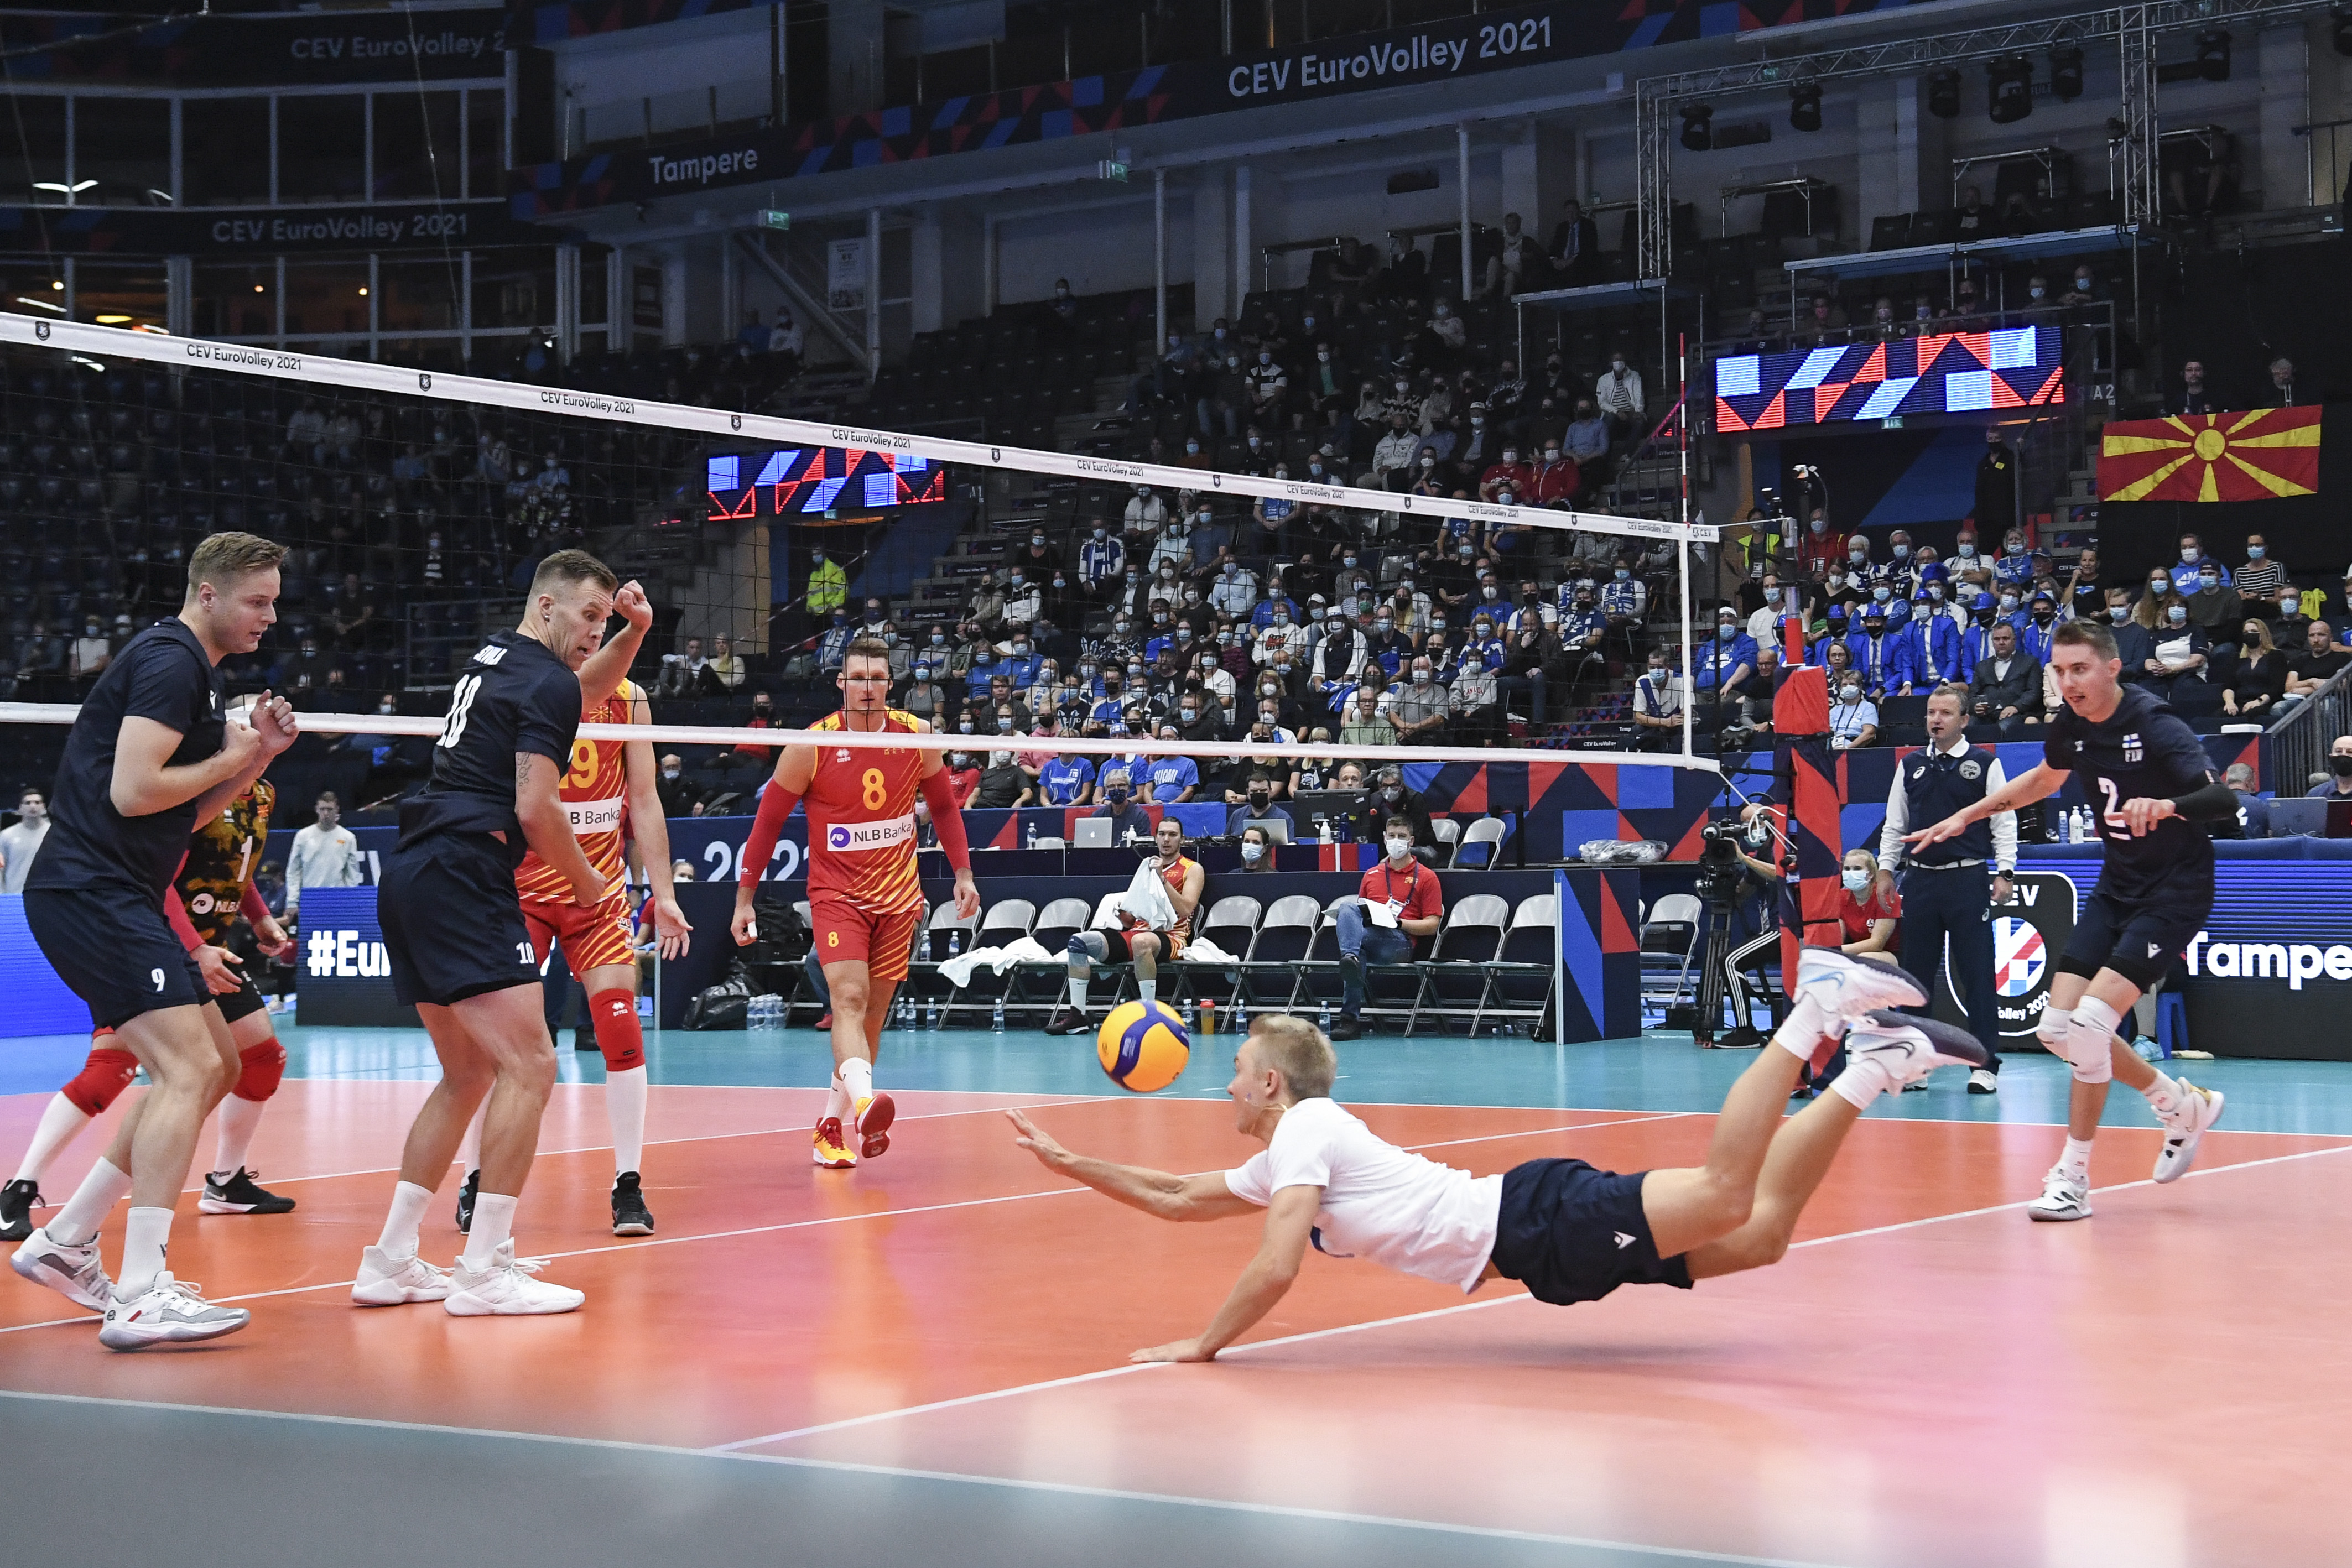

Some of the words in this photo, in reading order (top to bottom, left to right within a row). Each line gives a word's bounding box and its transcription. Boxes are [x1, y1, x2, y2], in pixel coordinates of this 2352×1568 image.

[291, 37, 344, 59] CEV
[352, 32, 485, 58] EuroVolley
[1229, 60, 1291, 97] CEV
[1302, 35, 1468, 87] EuroVolley
[1480, 17, 1551, 58] 2021
[649, 148, 758, 184] Tampere
[212, 220, 264, 243] CEV
[272, 216, 404, 242] EuroVolley
[413, 213, 468, 238] 2021
[187, 343, 211, 359] CEV
[214, 347, 274, 372] EuroVolley
[277, 357, 301, 371] 2021
[540, 391, 560, 405] CEV
[563, 394, 612, 414] EuroVolley
[615, 402, 634, 414] 2021
[832, 429, 849, 441] CEV
[851, 431, 892, 449] EuroVolley
[893, 436, 910, 449] 2021
[1077, 460, 1091, 470] CEV
[1092, 461, 1127, 477] EuroVolley
[1129, 466, 1144, 477] 2021
[1287, 485, 1299, 494] CEV
[1300, 486, 1330, 499] EuroVolley
[1332, 489, 1345, 499] 2021
[1469, 505, 1479, 514] CEV
[1700, 529, 1711, 537] CEV
[436, 674, 482, 748] 10
[1154, 769, 1178, 785] SUOMI
[862, 768, 887, 811] 8
[2098, 777, 2127, 829] 2
[585, 807, 621, 825] Banka
[854, 829, 881, 842] NLB
[883, 822, 912, 840] Banka
[237, 835, 253, 883] 1
[828, 931, 839, 947] 8
[516, 942, 535, 965] 10
[2186, 931, 2352, 990] Tampe
[151, 968, 165, 993] 9
[1997, 1006, 2026, 1021] olley
